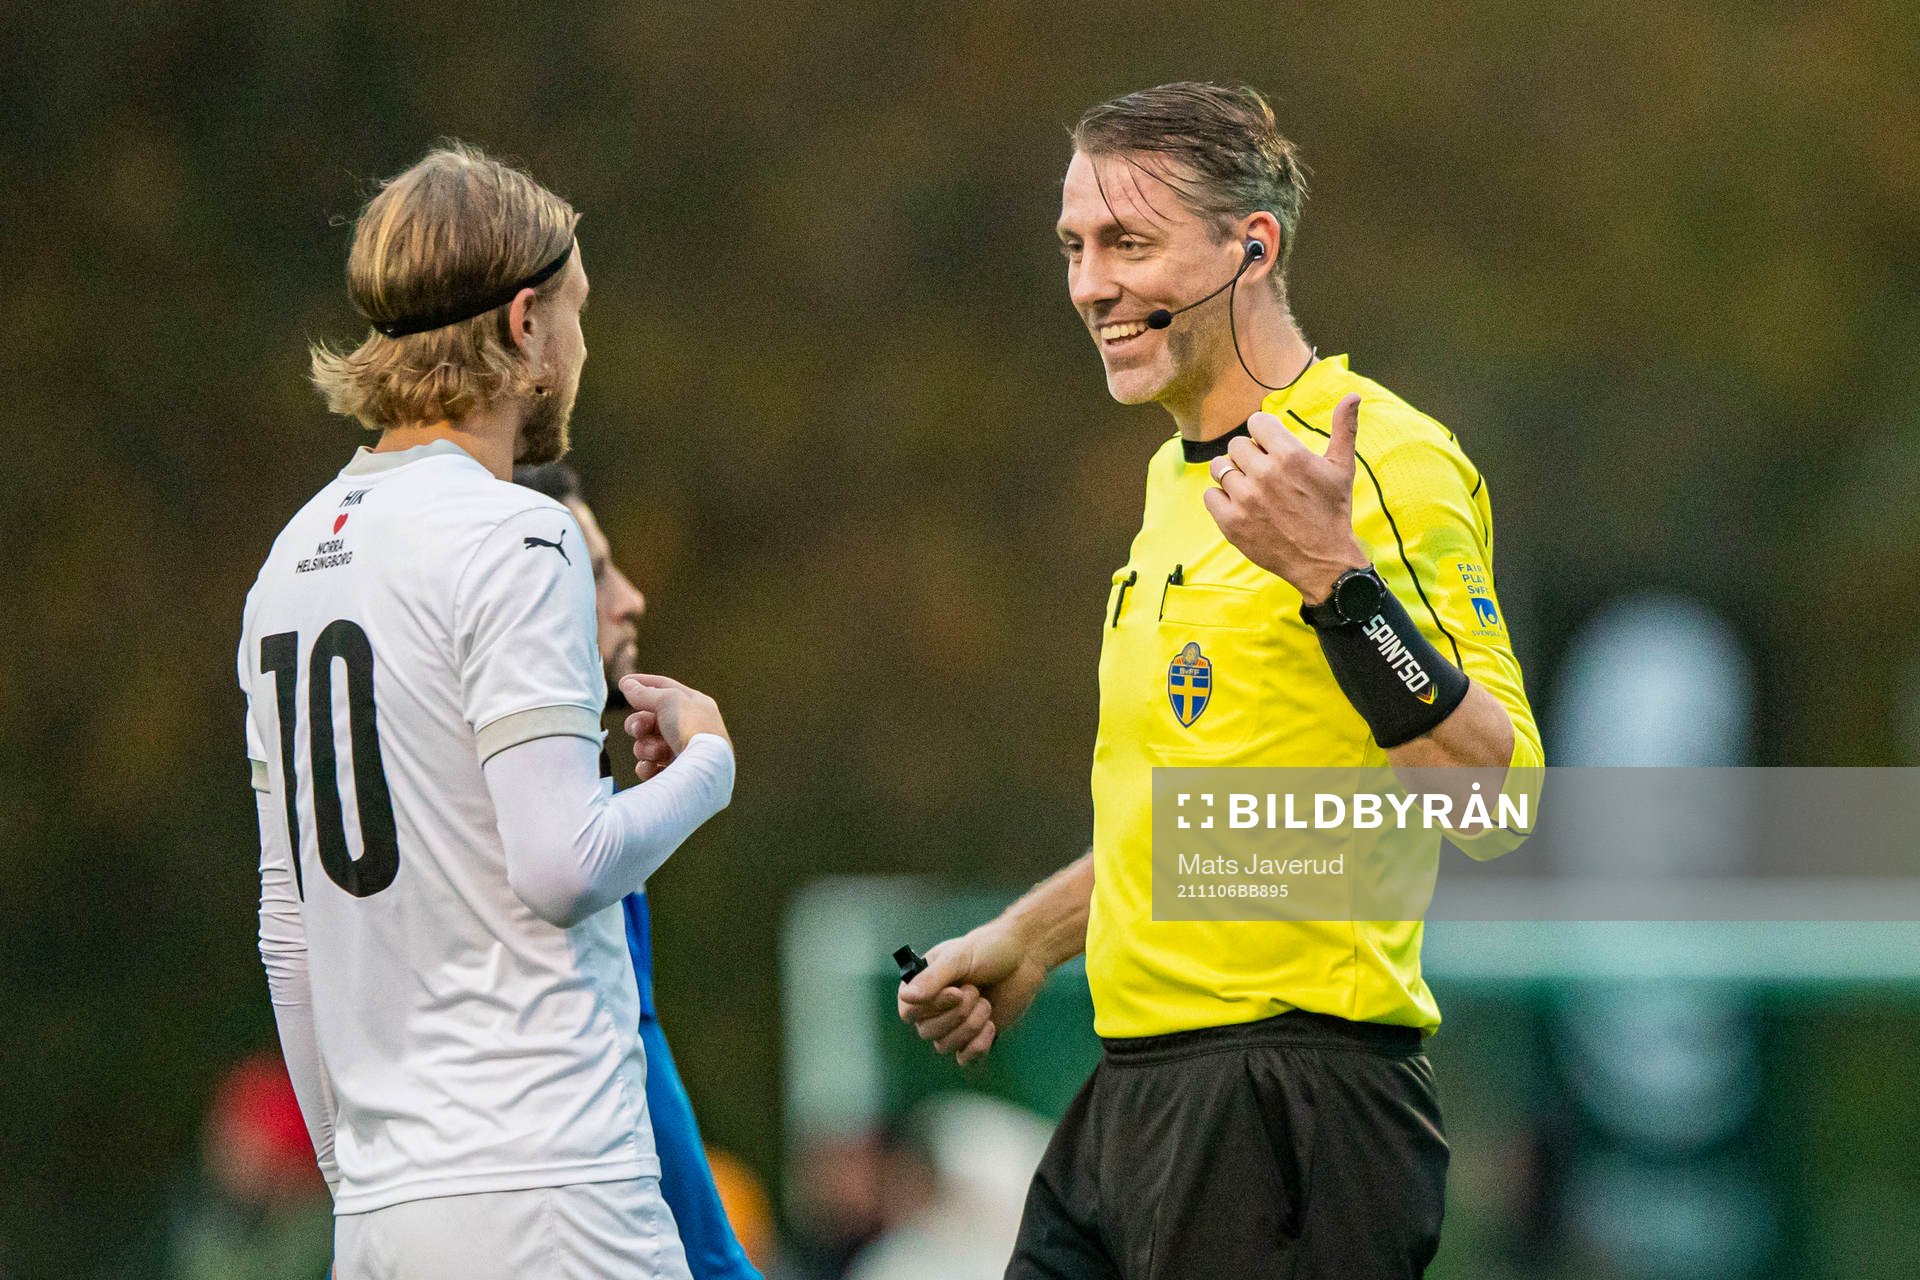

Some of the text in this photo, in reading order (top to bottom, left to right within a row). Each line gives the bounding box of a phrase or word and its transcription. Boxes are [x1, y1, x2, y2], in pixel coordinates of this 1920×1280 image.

[339, 487, 373, 508] HIK
[316, 539, 344, 556] NORRA
[296, 551, 353, 574] HELSINGBORG
[1362, 614, 1430, 693] SPINTSO
[260, 619, 400, 903] 10
